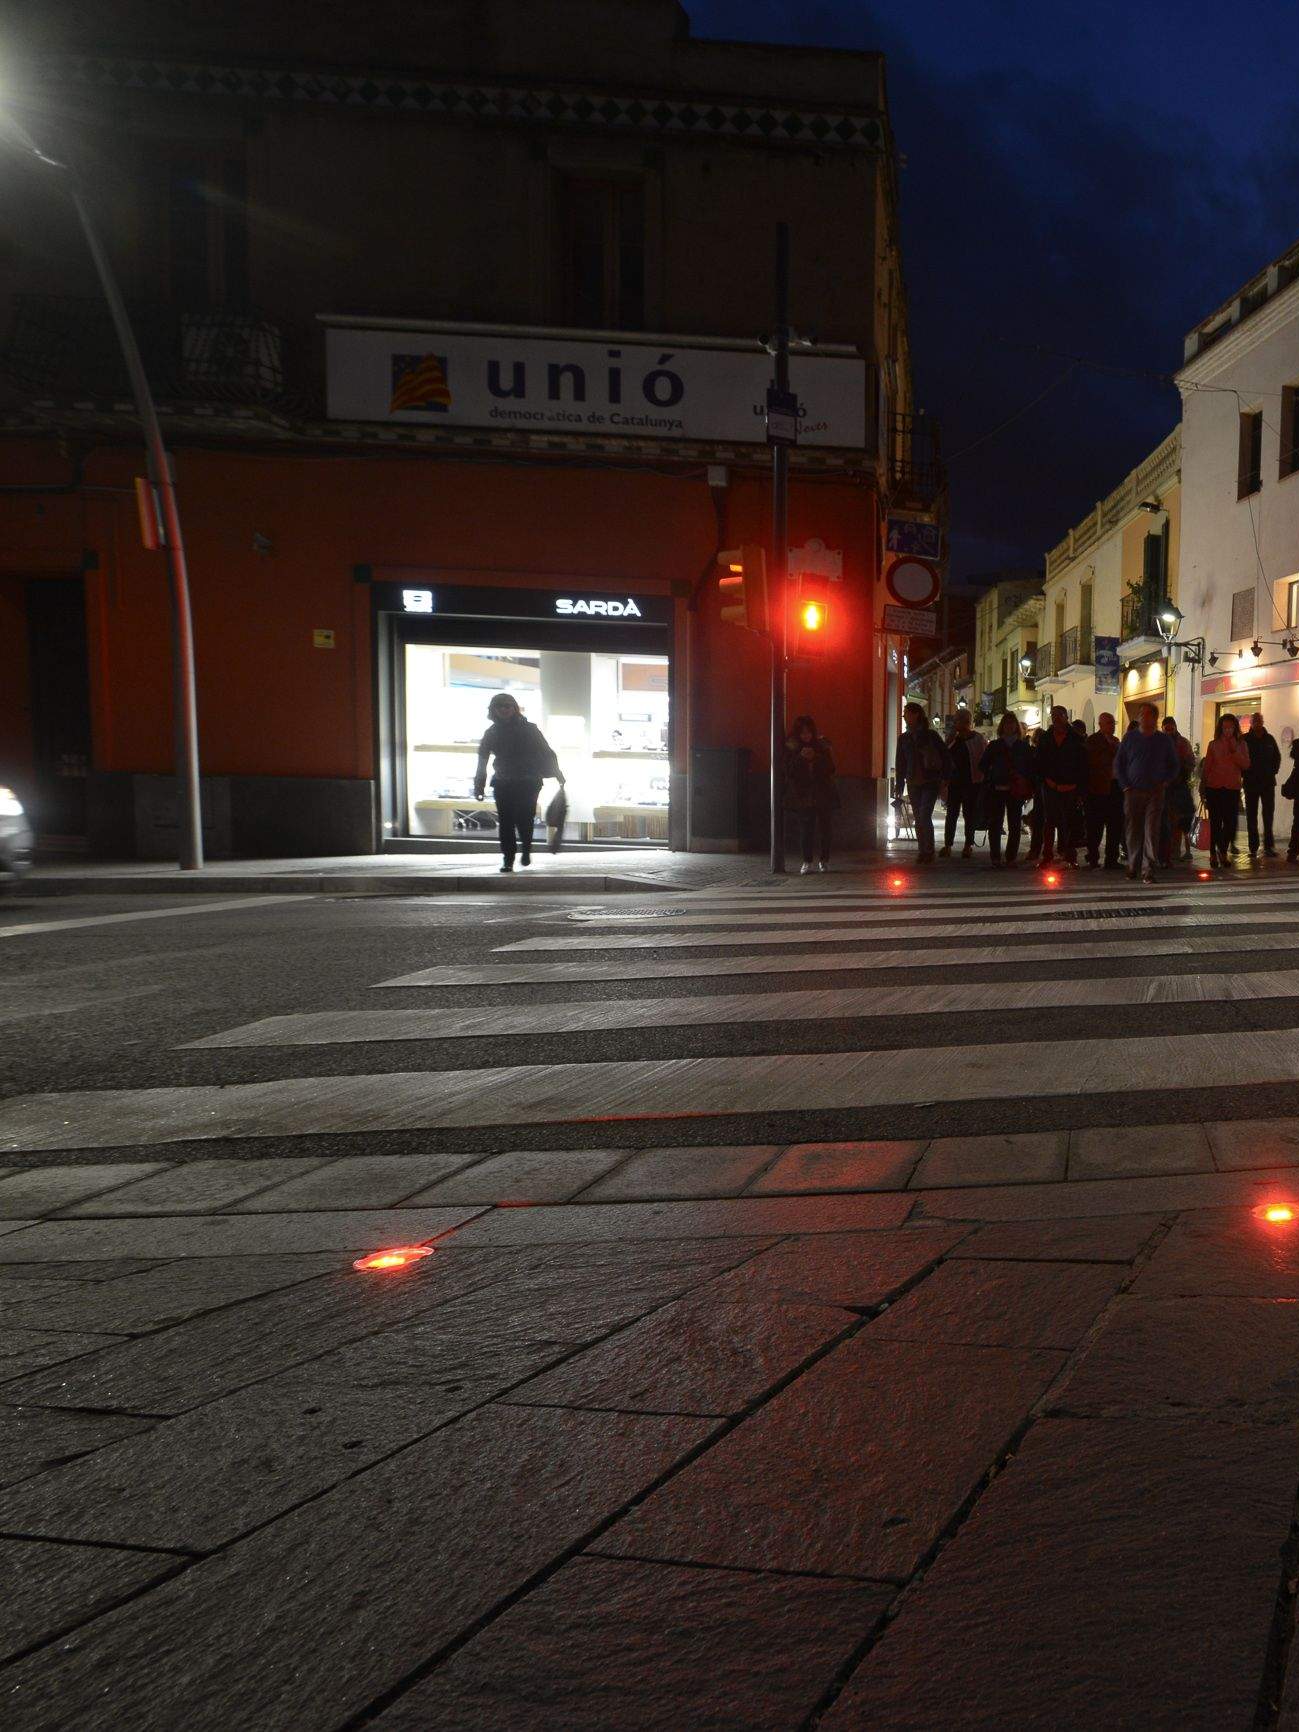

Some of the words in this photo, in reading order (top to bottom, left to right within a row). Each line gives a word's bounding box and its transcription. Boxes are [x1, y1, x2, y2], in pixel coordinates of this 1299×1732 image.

[487, 349, 684, 407] unió
[587, 411, 605, 424] de
[610, 413, 684, 430] Catalunya
[555, 598, 642, 617] SARDÀ
